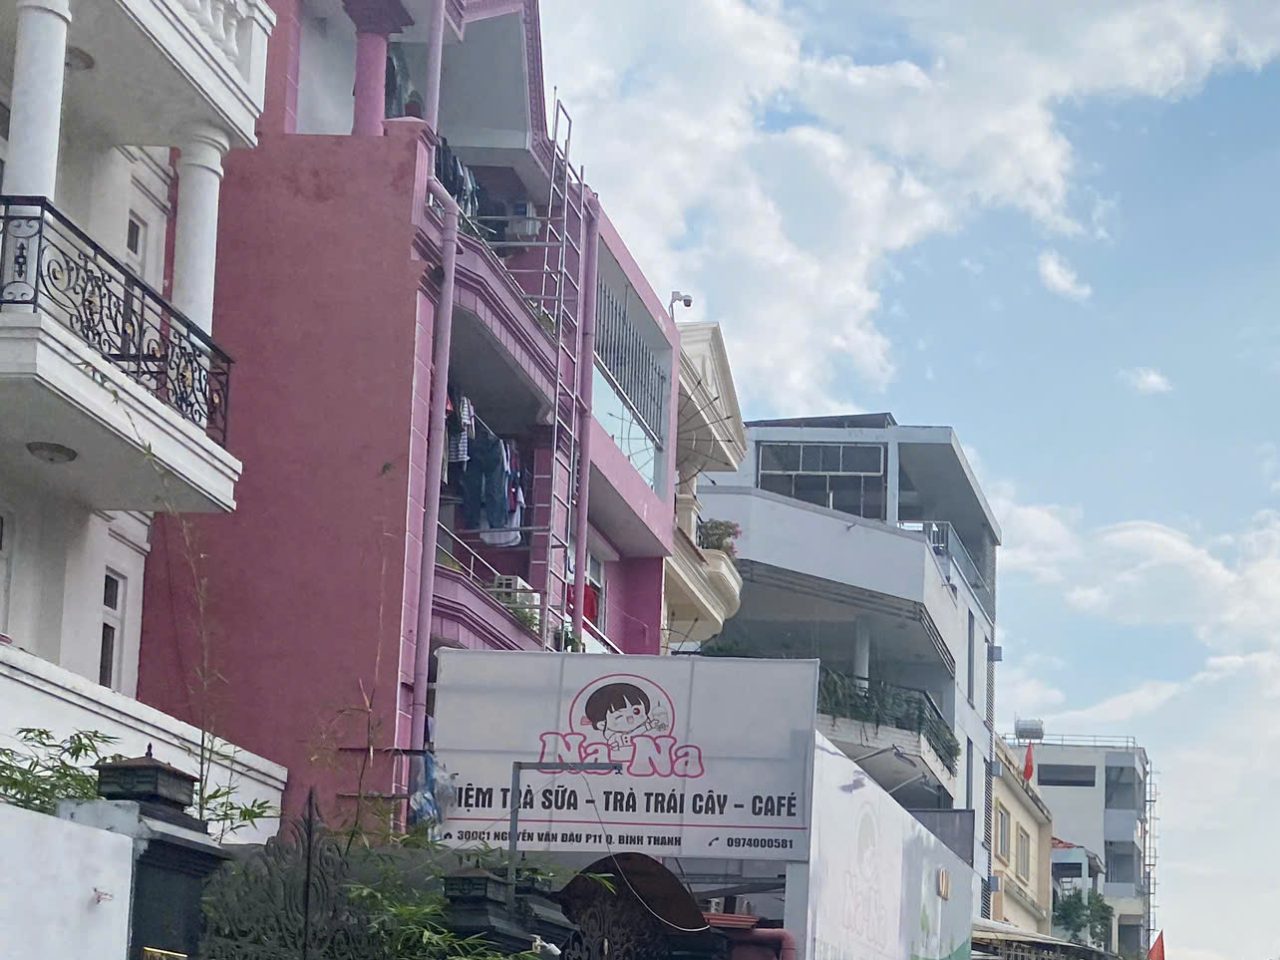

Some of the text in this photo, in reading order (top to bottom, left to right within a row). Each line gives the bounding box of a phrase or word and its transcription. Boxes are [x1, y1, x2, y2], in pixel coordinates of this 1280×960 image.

[457, 783, 494, 812] IỆM
[542, 785, 578, 810] SỮA
[603, 787, 637, 812] TRÀ
[644, 788, 685, 814] TRÁI
[692, 790, 728, 815] CÂY
[751, 792, 797, 817] CAFÉ
